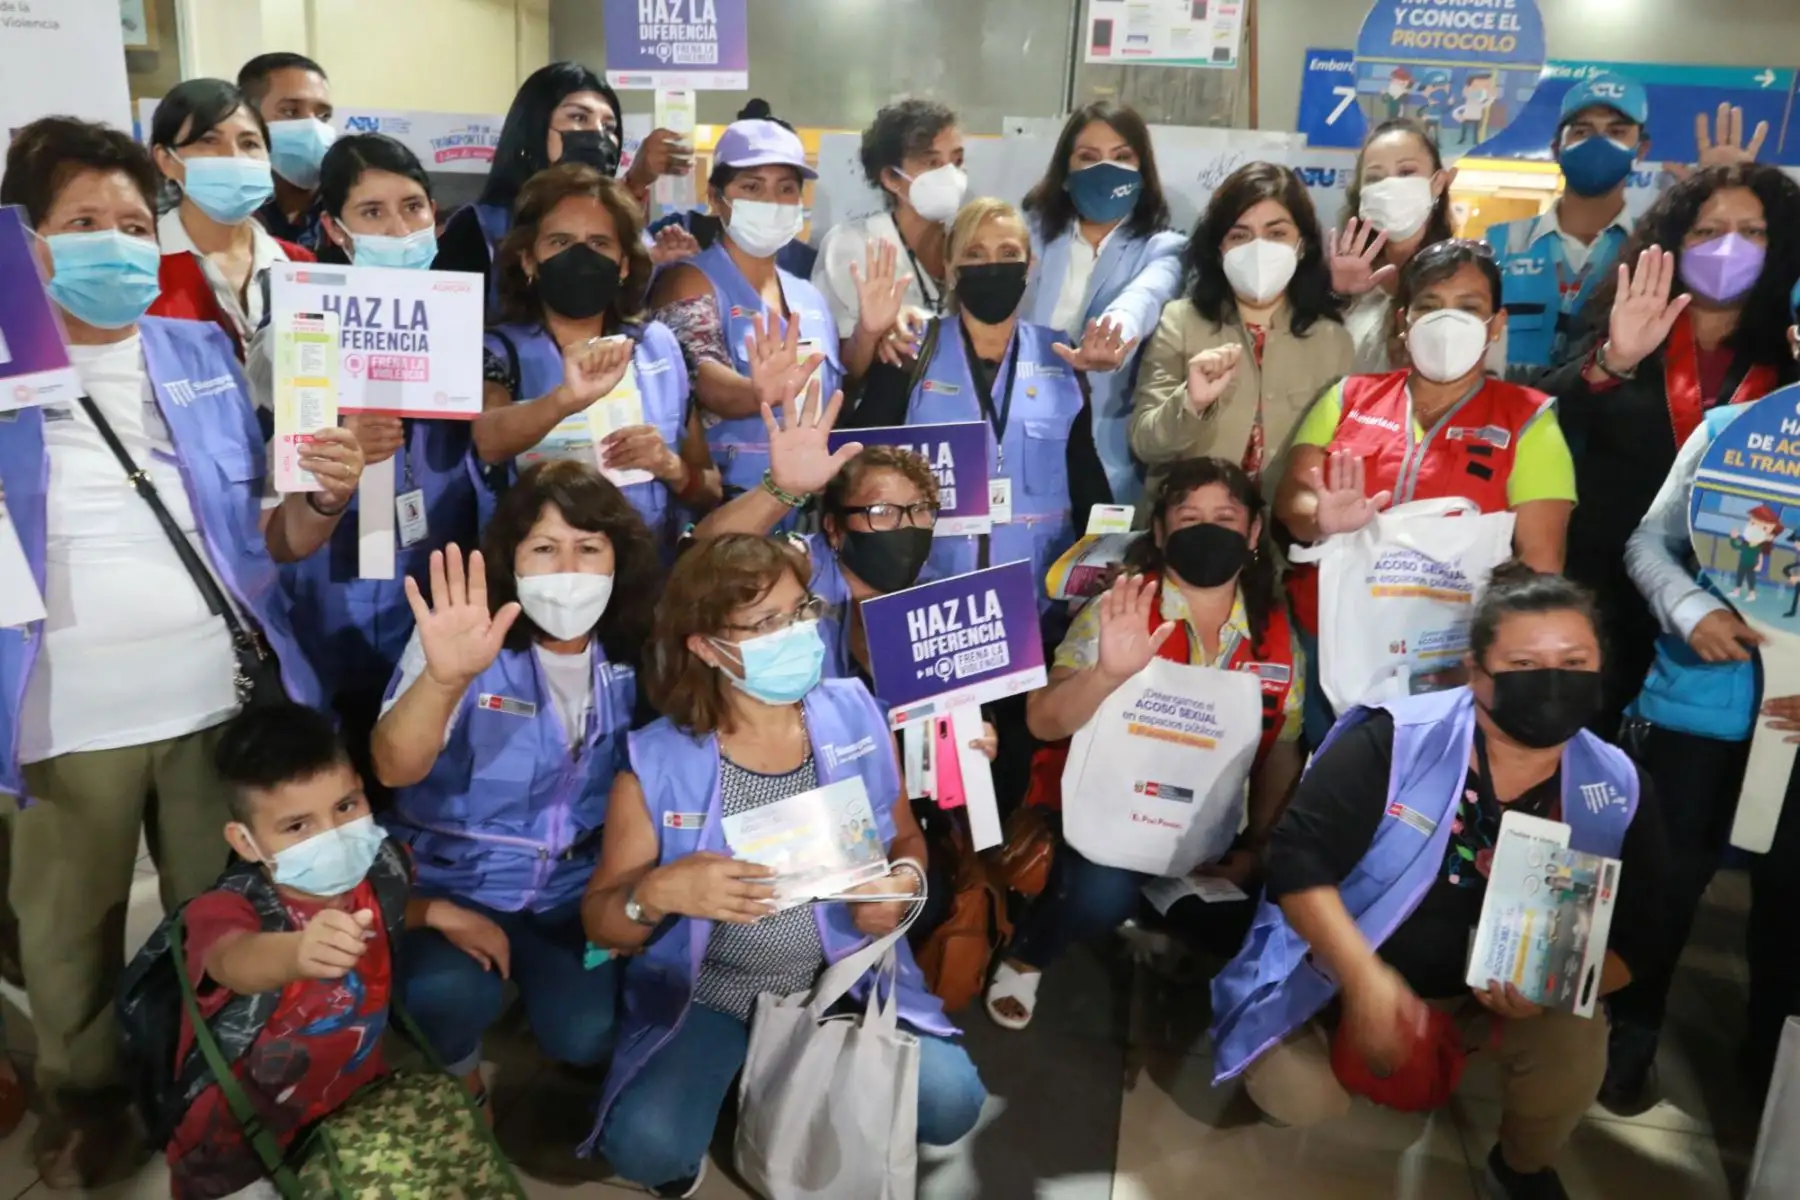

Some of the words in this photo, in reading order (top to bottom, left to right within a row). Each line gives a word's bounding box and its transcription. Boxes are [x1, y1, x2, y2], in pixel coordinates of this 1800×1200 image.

[690, 0, 717, 24] LA
[1395, 9, 1408, 25] Y
[1409, 10, 1494, 30] CONOCE
[1498, 14, 1521, 31] EL
[640, 24, 718, 40] DIFERENCIA
[1391, 30, 1516, 52] PROTOCOLO
[1325, 86, 1356, 126] 7
[345, 116, 379, 131] ATU
[394, 298, 429, 331] LA
[1748, 432, 1774, 452] DE
[1724, 447, 1745, 467] EL
[1374, 560, 1418, 573] ACOSO
[907, 598, 962, 642] HAZ
[967, 588, 1003, 626] LA
[911, 620, 1006, 662] DIFERENCIA
[1122, 711, 1137, 721] en
[1138, 713, 1182, 730] espacios
[1136, 699, 1177, 715] ACOSO
[1179, 706, 1218, 725] SEXUAL
